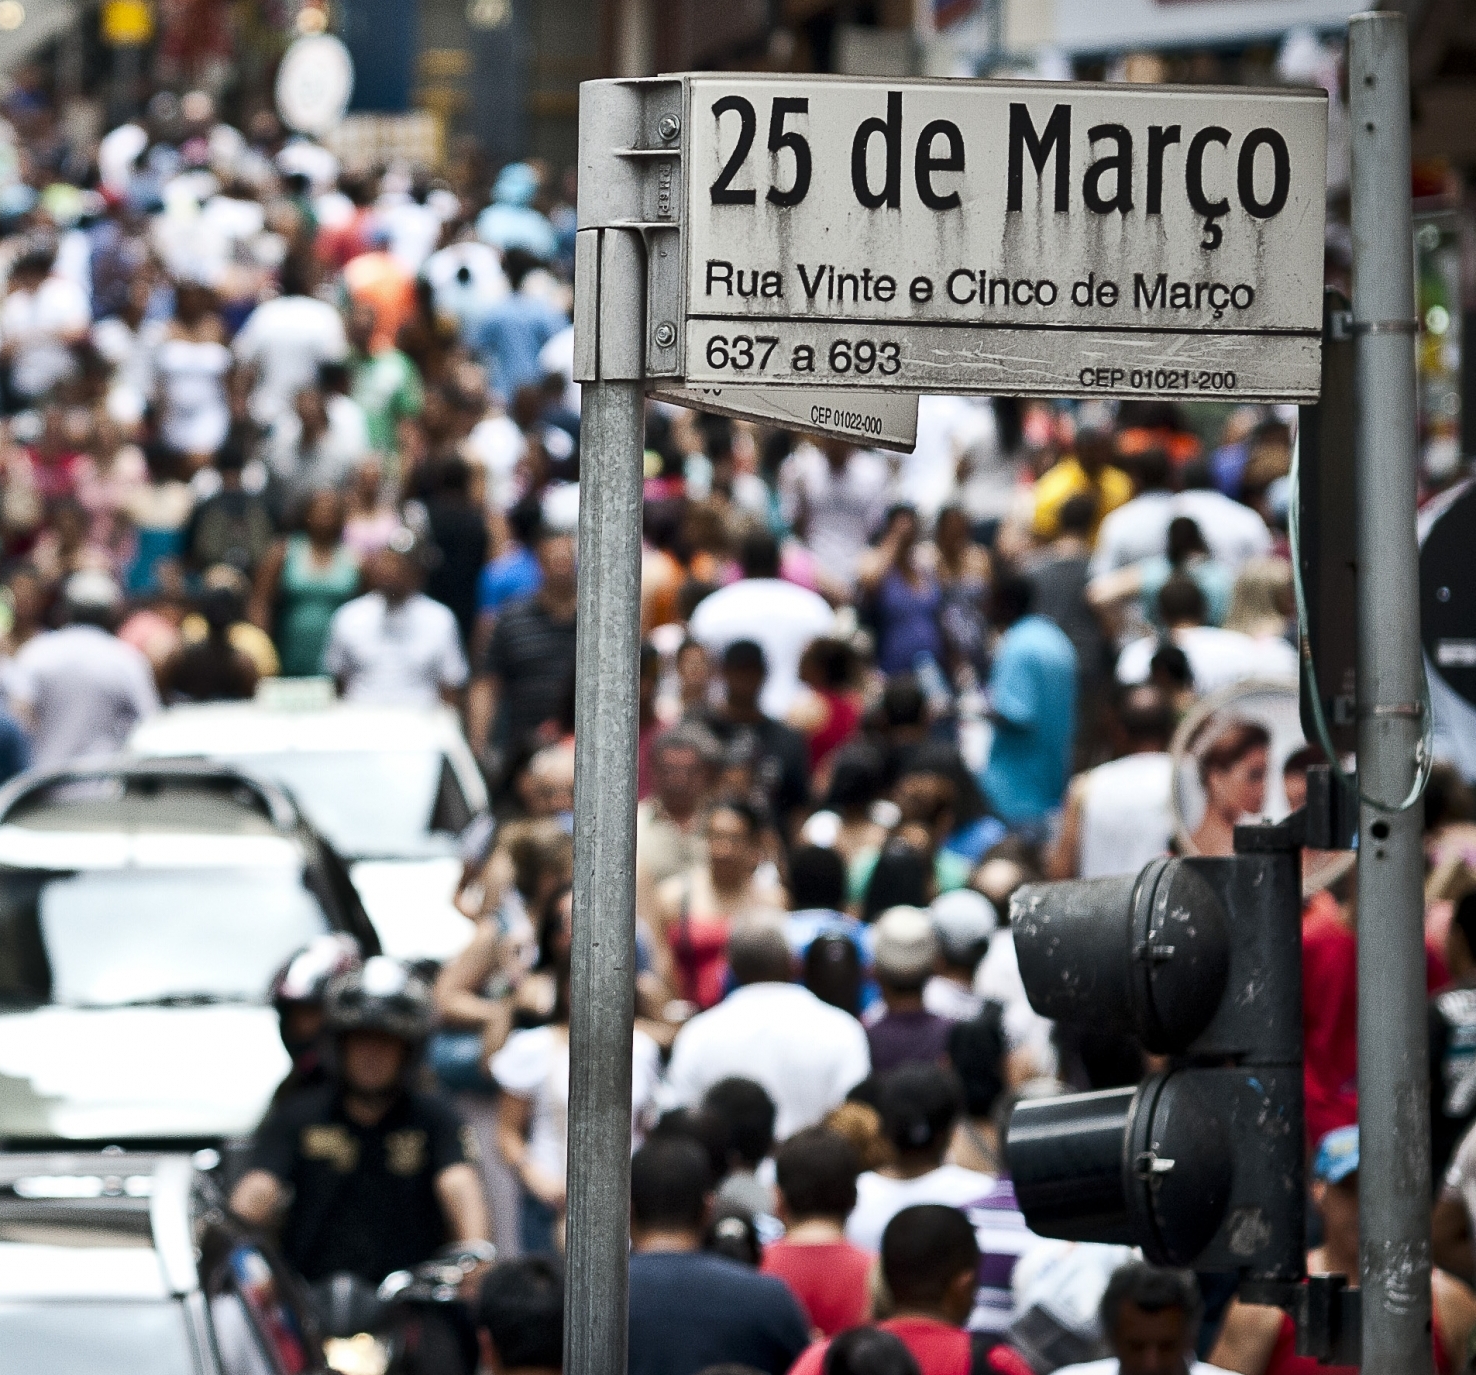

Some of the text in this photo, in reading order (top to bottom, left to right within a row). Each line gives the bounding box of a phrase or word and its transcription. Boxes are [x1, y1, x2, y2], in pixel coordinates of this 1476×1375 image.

[709, 91, 1291, 250] 25 de Março
[705, 259, 1255, 318] Rua Vinte e Cinco de Março
[705, 335, 902, 375] 637 a 693
[1079, 367, 1236, 389] CEP 01021-200
[811, 405, 883, 435] CEP 01022-000
